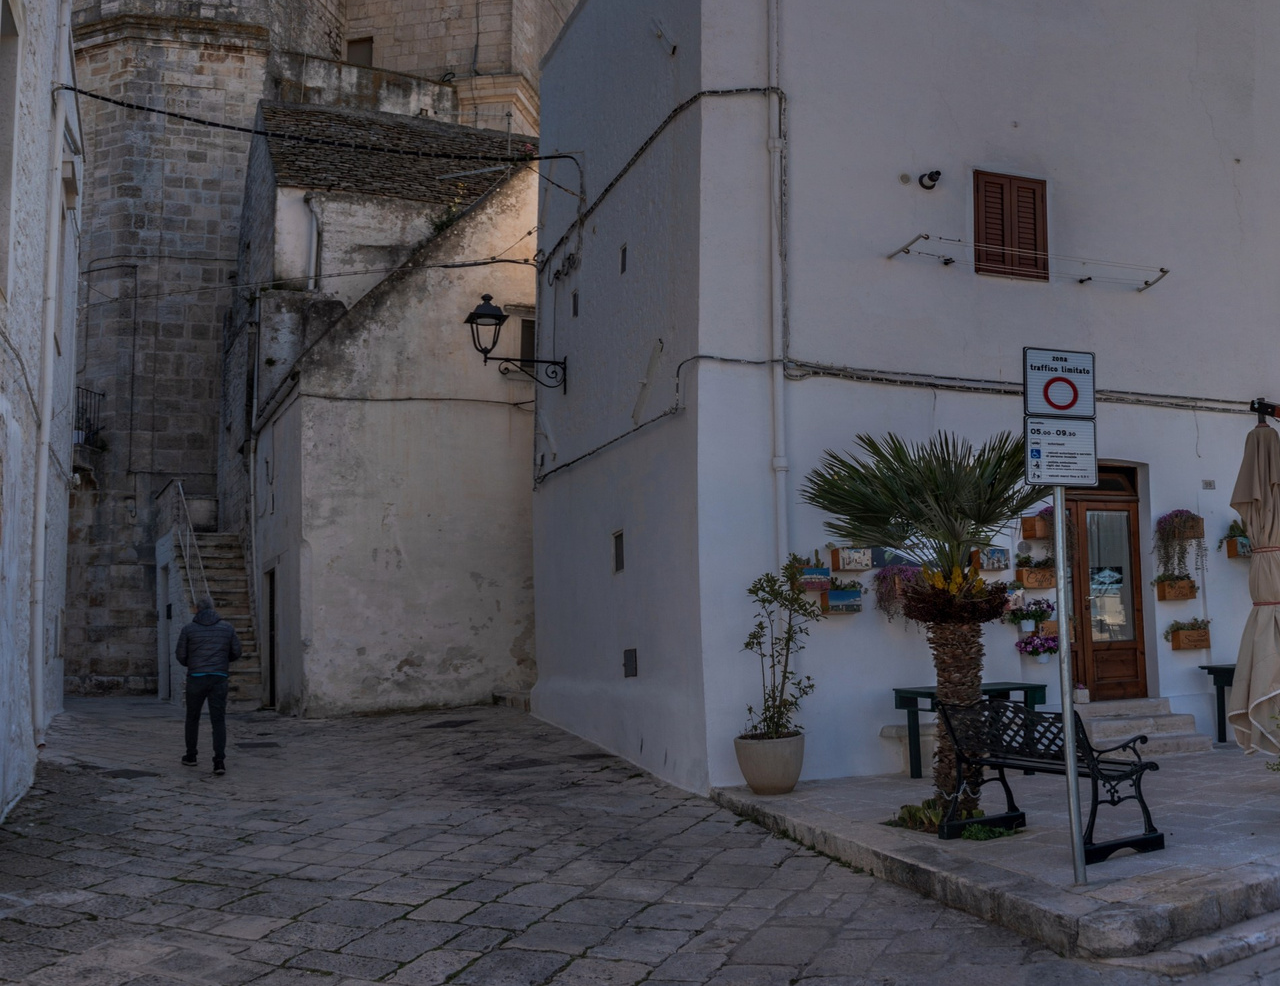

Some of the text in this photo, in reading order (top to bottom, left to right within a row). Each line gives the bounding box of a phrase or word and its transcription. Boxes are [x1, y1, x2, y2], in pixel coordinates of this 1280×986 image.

[1030, 364, 1091, 375] traffico limitato
[1030, 428, 1051, 436] 05.00
